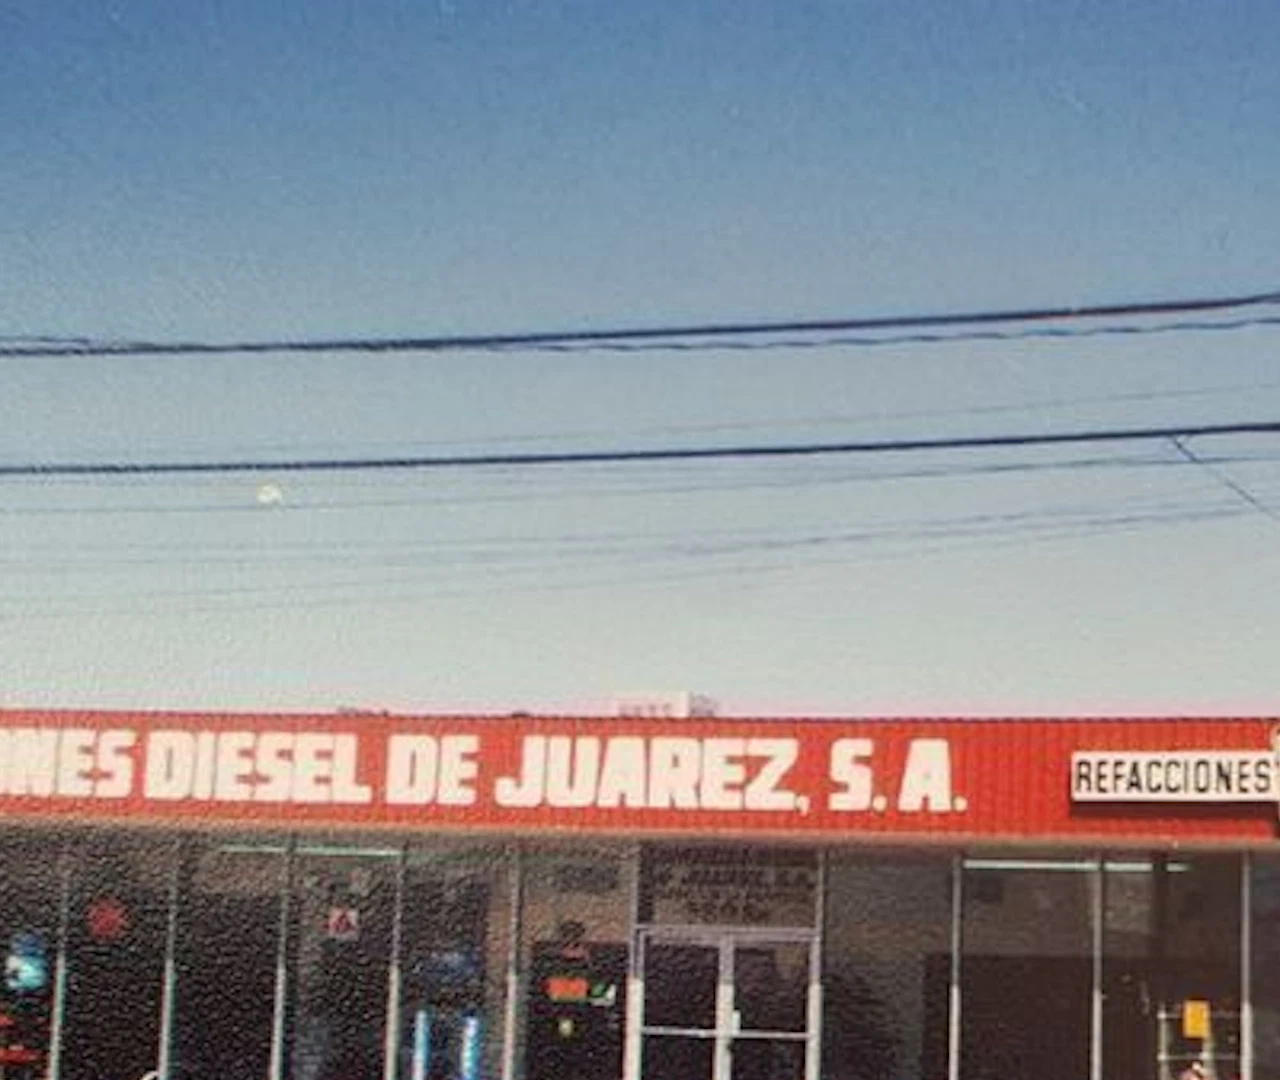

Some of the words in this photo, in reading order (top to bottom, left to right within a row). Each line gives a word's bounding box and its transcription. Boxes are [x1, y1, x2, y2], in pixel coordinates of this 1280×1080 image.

[143, 728, 373, 805] DIESEL
[384, 733, 482, 807] DE
[1074, 758, 1274, 795] REFACCIONES
